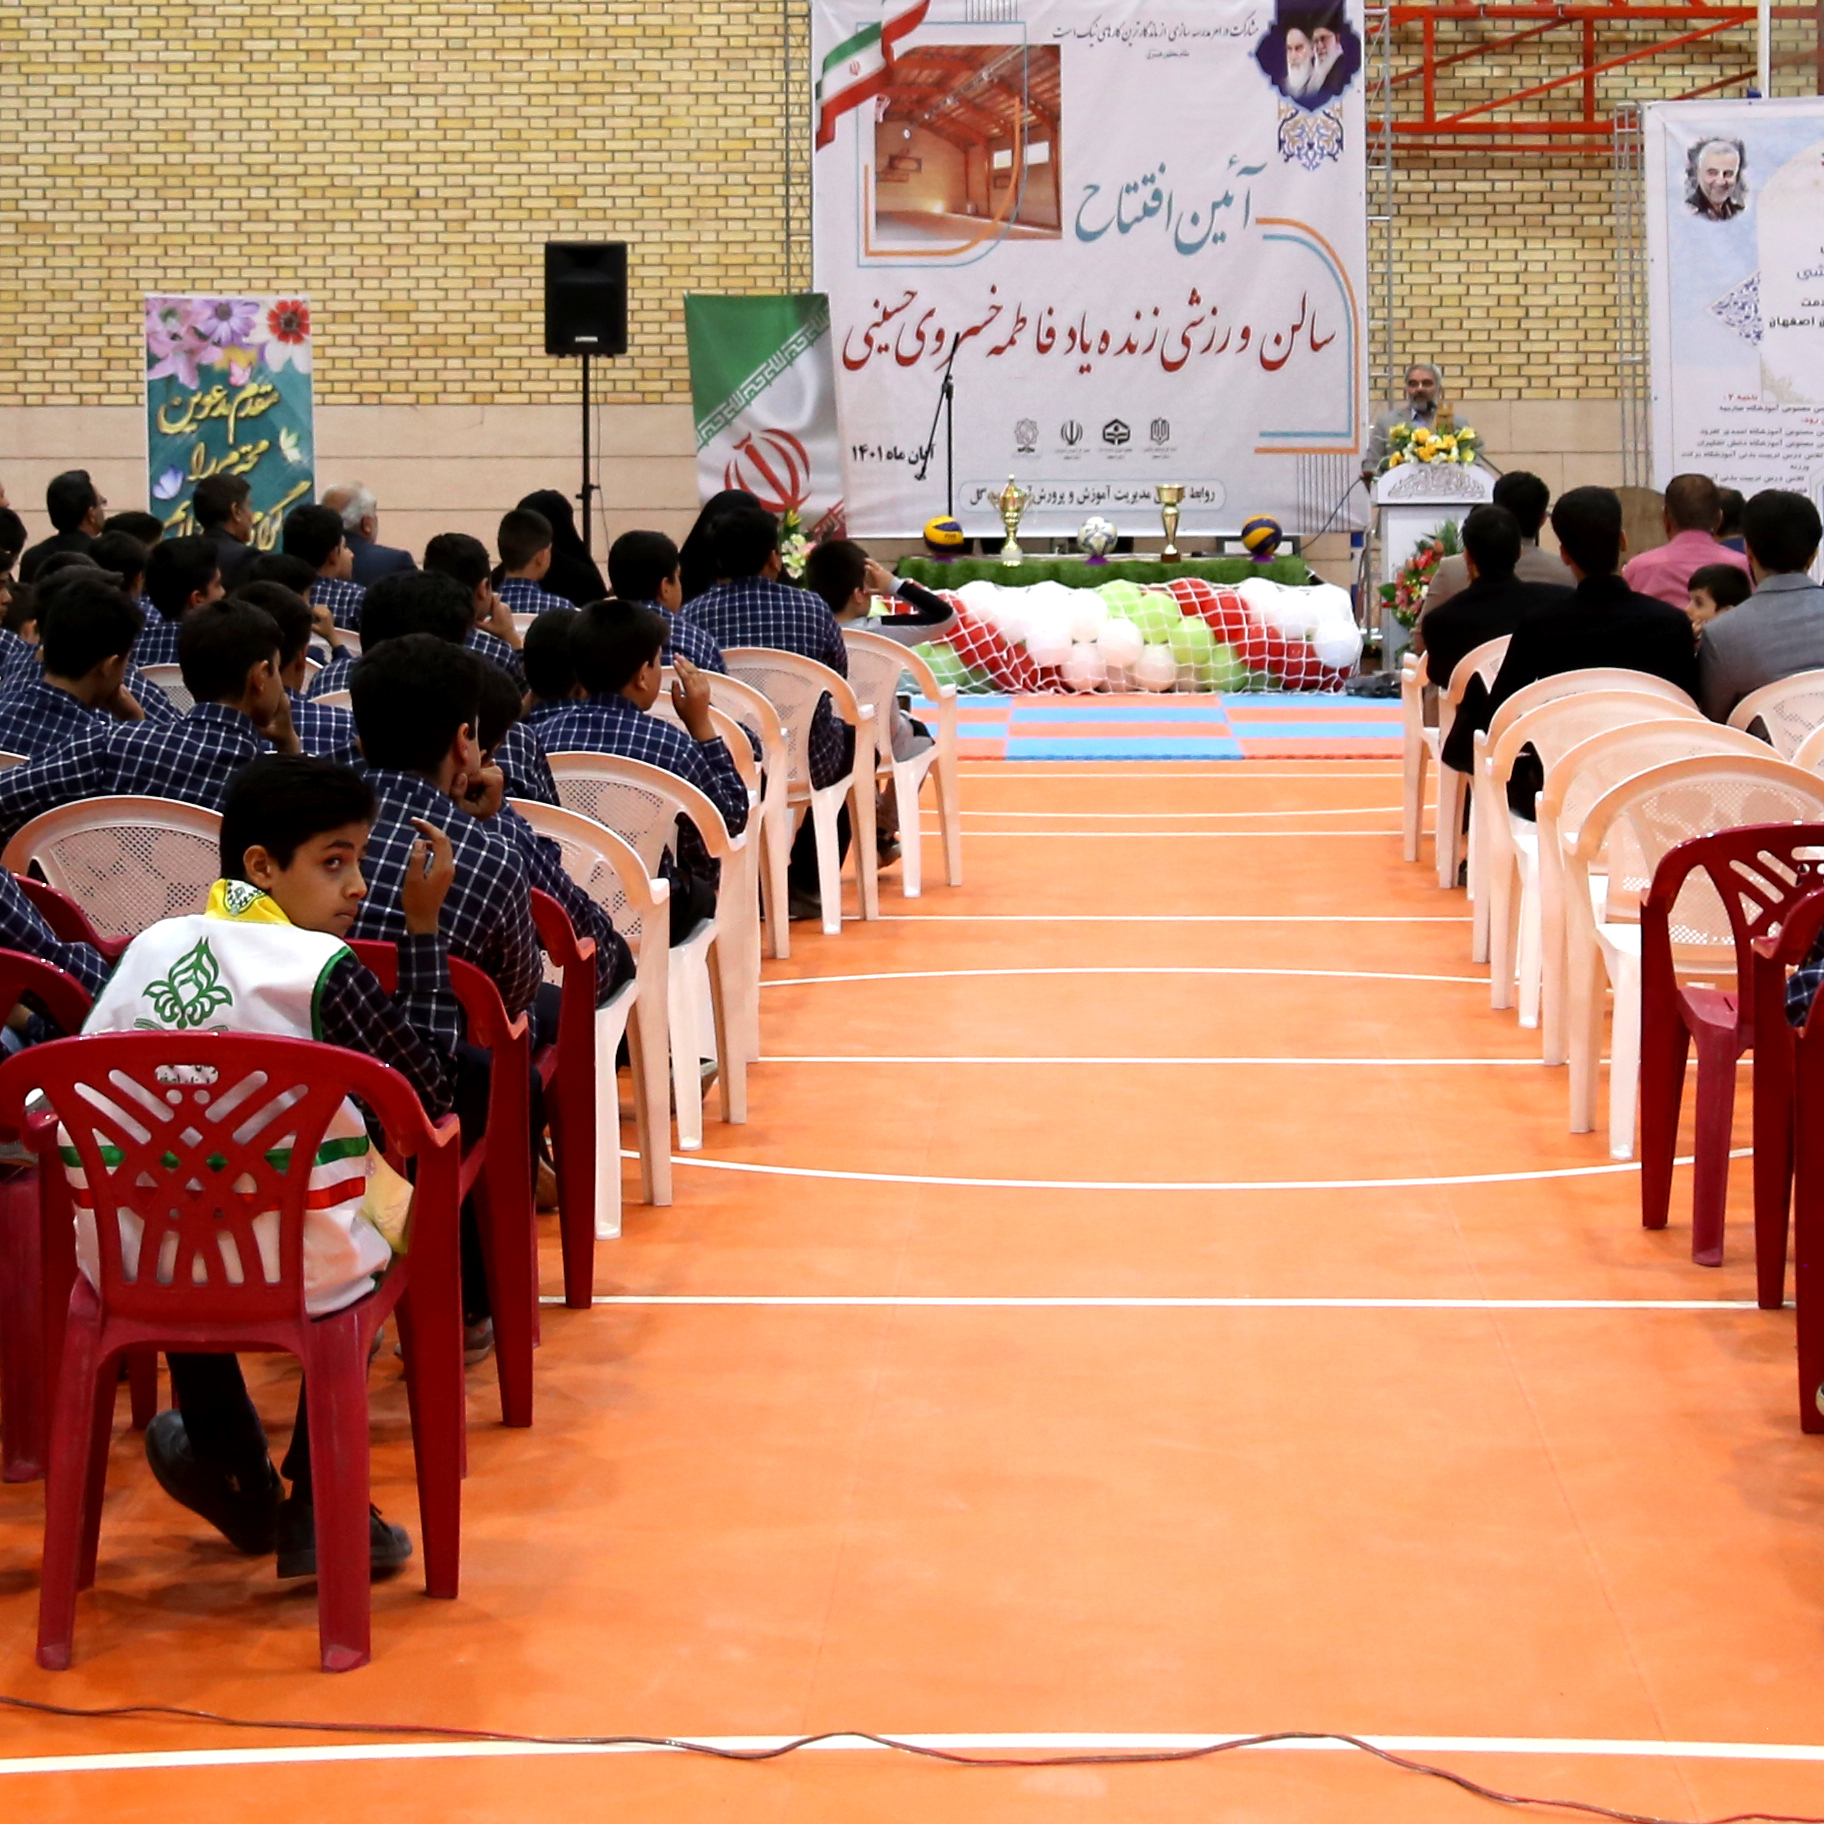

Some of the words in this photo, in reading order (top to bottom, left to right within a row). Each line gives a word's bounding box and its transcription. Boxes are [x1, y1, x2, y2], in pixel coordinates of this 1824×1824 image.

[1076, 162, 1173, 243] افتتاح
[1175, 154, 1268, 256] آئین
[842, 289, 919, 372] حسینی
[894, 283, 1004, 374] خسروی
[985, 301, 1057, 358] فاطمه
[1160, 286, 1252, 373] ورزشی
[1259, 289, 1337, 372] سالن
[1769, 315, 1816, 328] اصفهان
[851, 443, 884, 462] ۱۴۰۱
[885, 445, 906, 461] ماه
[1034, 488, 1066, 505] پرورش
[1076, 485, 1111, 505] آموزش
[1114, 488, 1152, 504] مدیریت
[1189, 486, 1216, 504] روابط
